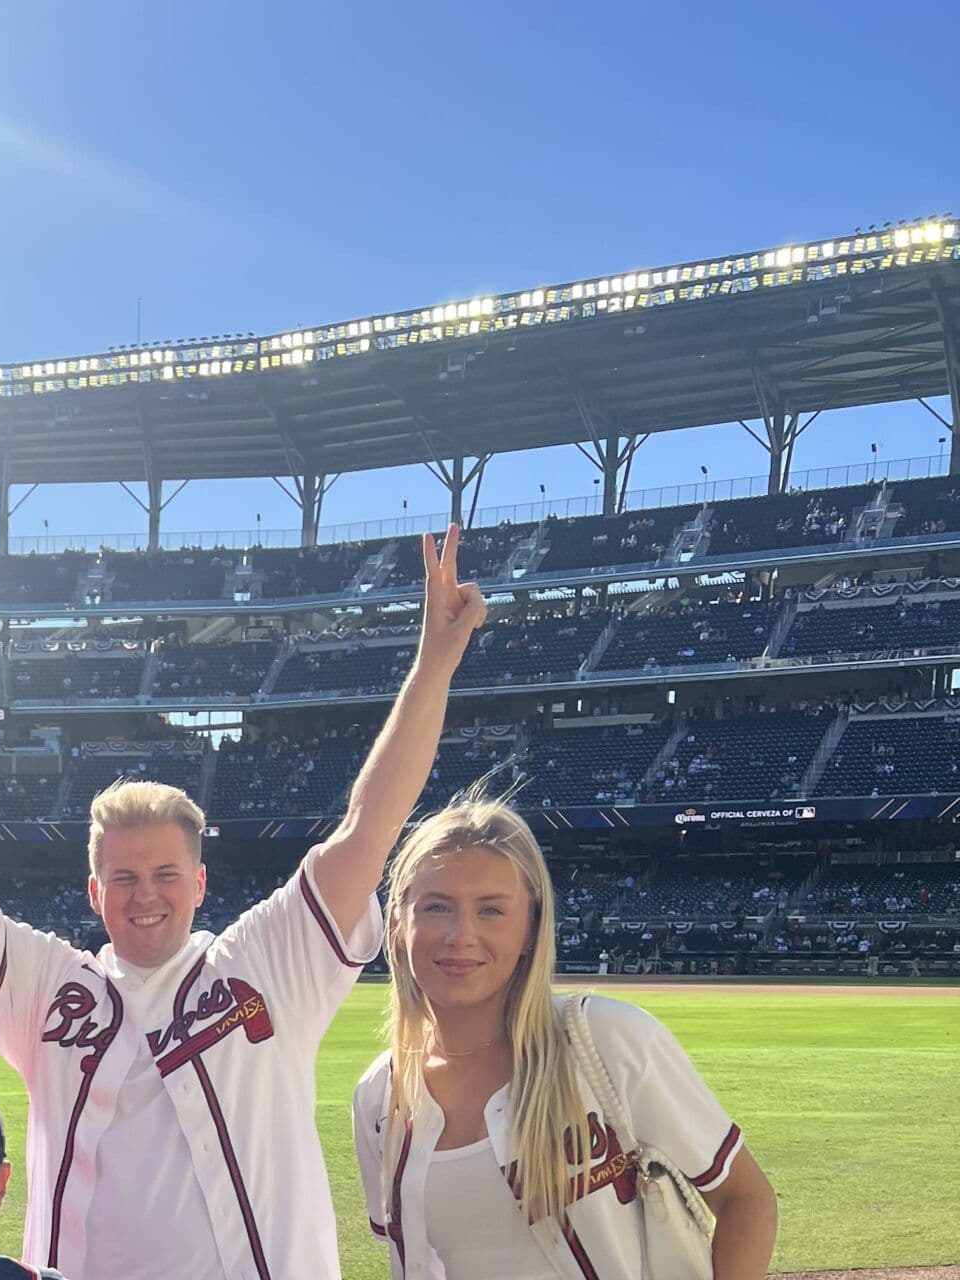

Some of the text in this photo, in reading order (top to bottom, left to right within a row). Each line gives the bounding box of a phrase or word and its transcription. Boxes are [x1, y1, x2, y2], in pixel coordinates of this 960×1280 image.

[711, 810, 745, 819] OFFICIAL
[746, 809, 781, 818] CERVEZA
[782, 809, 793, 817] OF
